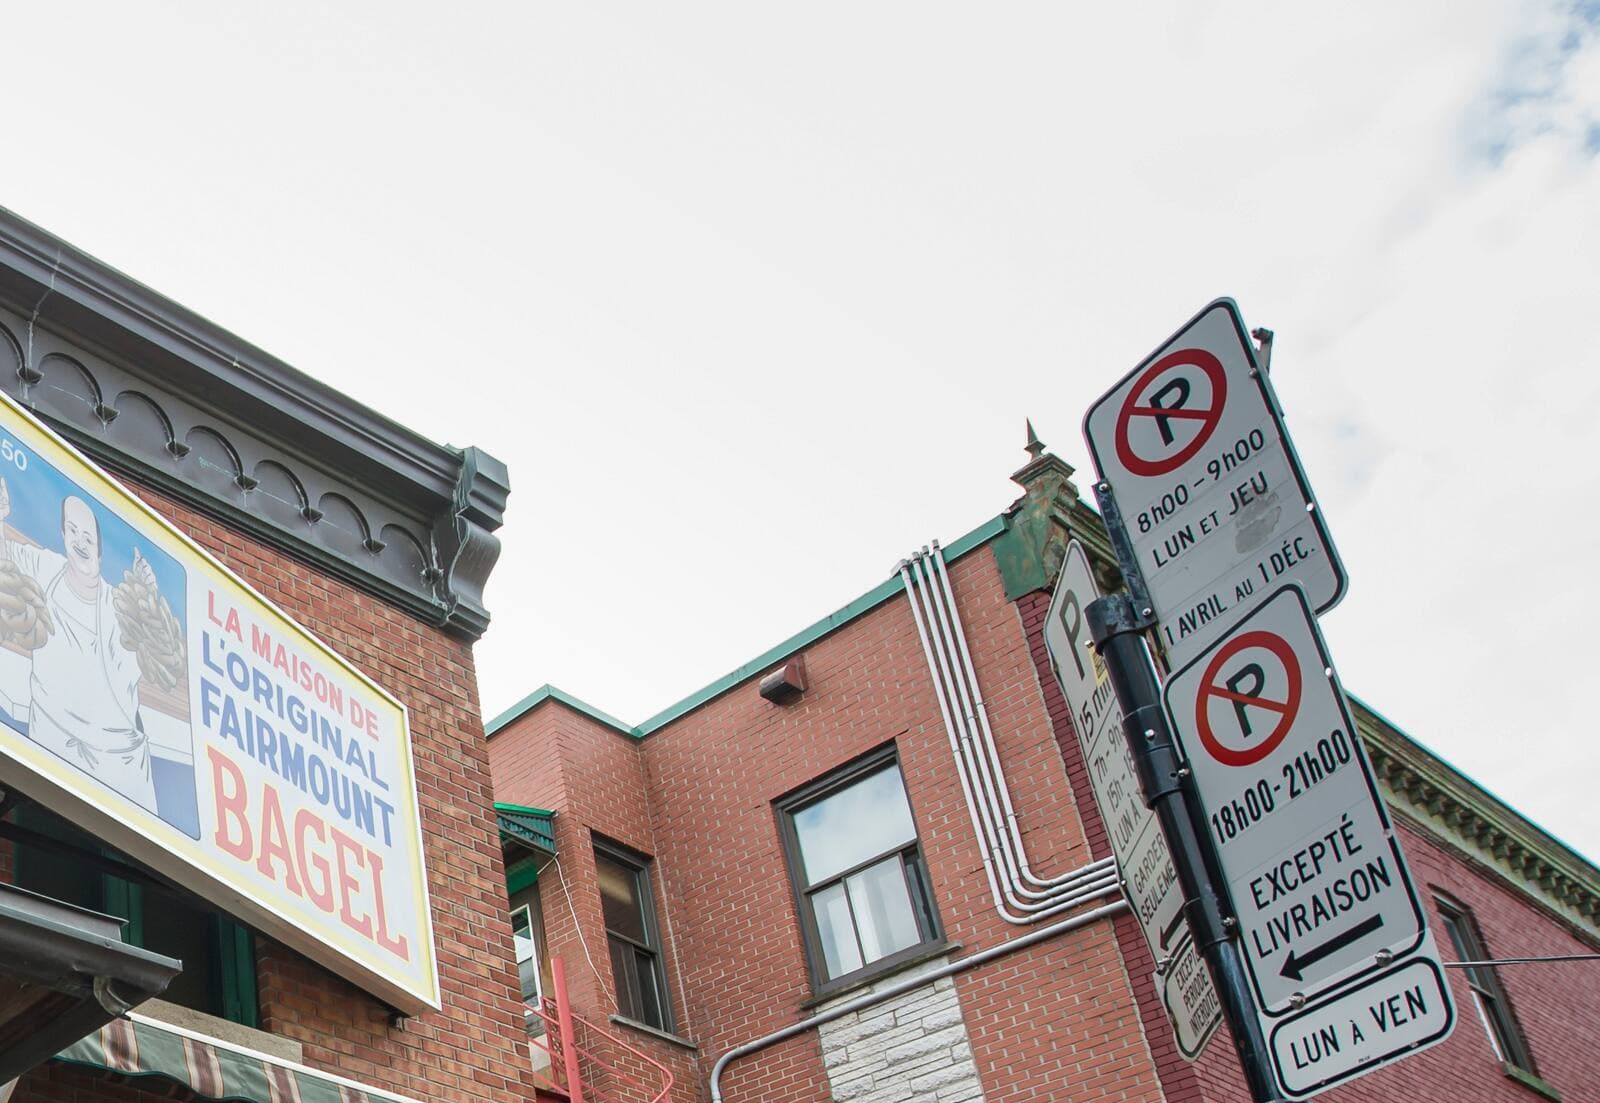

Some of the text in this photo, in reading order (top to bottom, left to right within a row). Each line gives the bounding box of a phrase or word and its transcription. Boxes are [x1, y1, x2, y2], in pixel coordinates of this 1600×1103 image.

[1153, 471, 1268, 568] LUN ET JEU
[1059, 589, 1085, 681] P
[1164, 625, 1175, 645] 1
[1179, 590, 1229, 639] AVRIL
[1235, 578, 1254, 602] AU
[202, 631, 389, 791] L'ORIGINAL
[208, 590, 380, 741] LA MAISON DE
[201, 677, 394, 848] FAIRMOUNT
[1080, 700, 1094, 744] 15
[207, 745, 410, 962] BAGEL
[1114, 808, 1135, 852] LUN
[1250, 813, 1363, 911] EXCEPTÉ
[1252, 856, 1392, 959] LIVRAISON
[1290, 985, 1428, 1070] LUN À VEN
